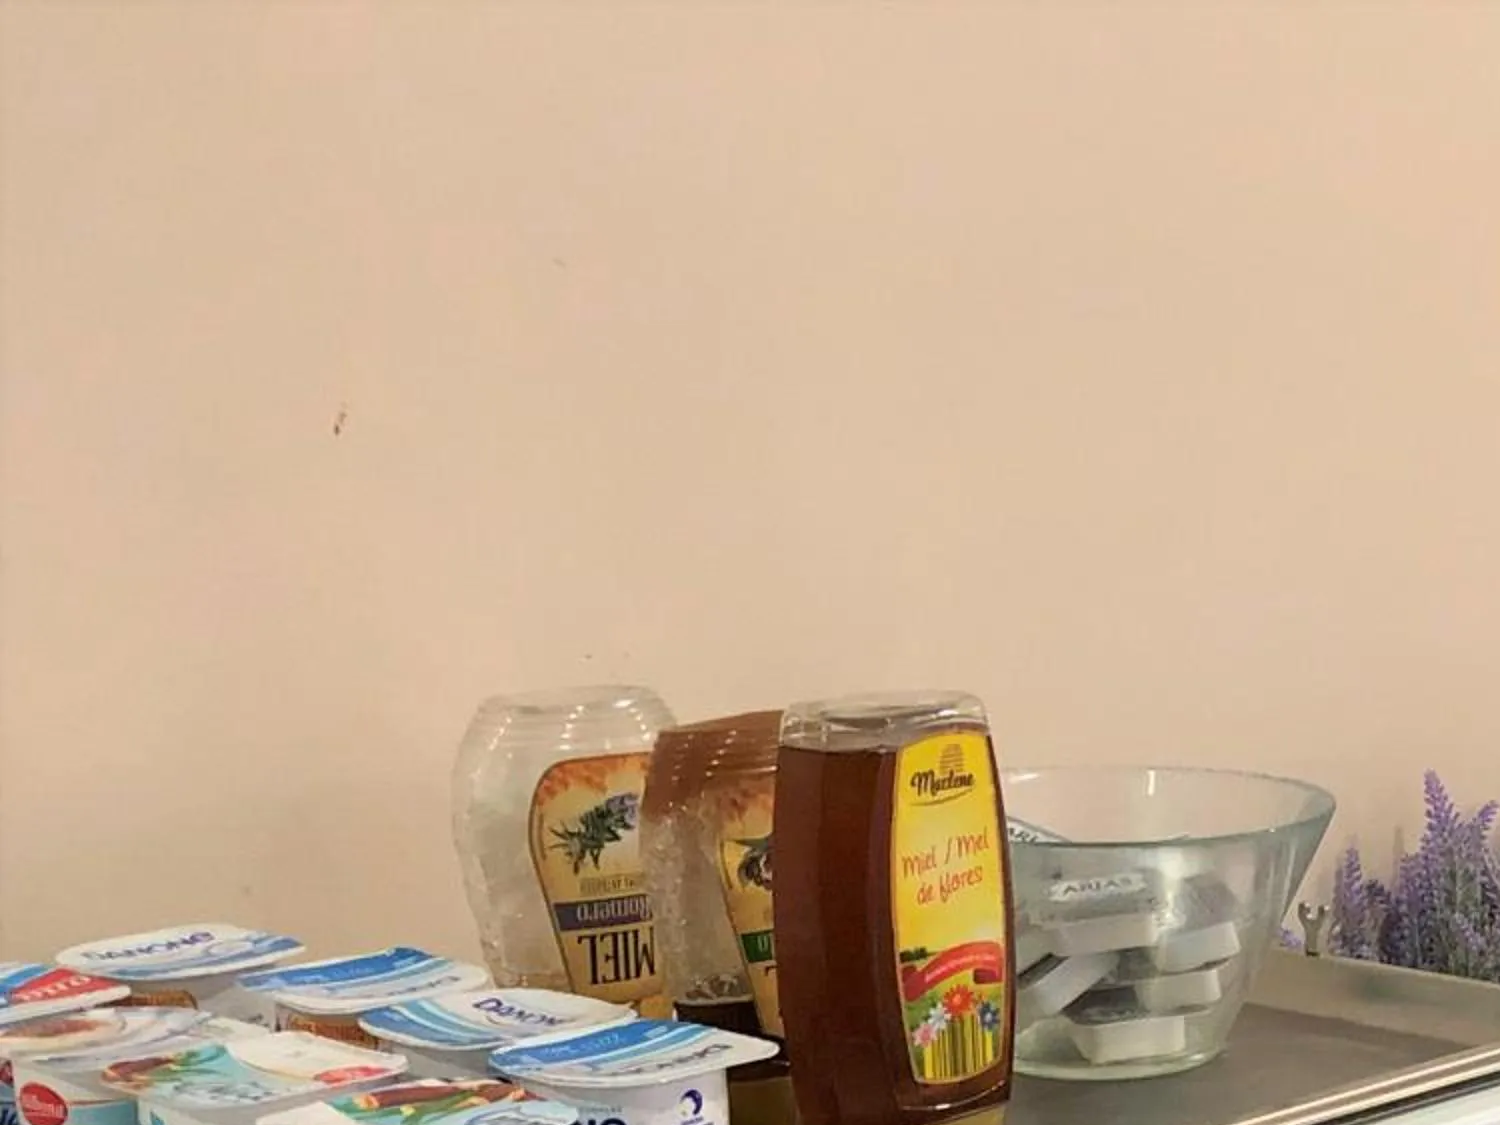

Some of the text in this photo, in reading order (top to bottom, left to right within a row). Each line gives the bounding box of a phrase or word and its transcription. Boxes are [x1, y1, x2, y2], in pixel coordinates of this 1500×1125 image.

[910, 769, 975, 797] Marlene
[917, 865, 984, 905] de flores
[577, 925, 656, 985] MIEL
